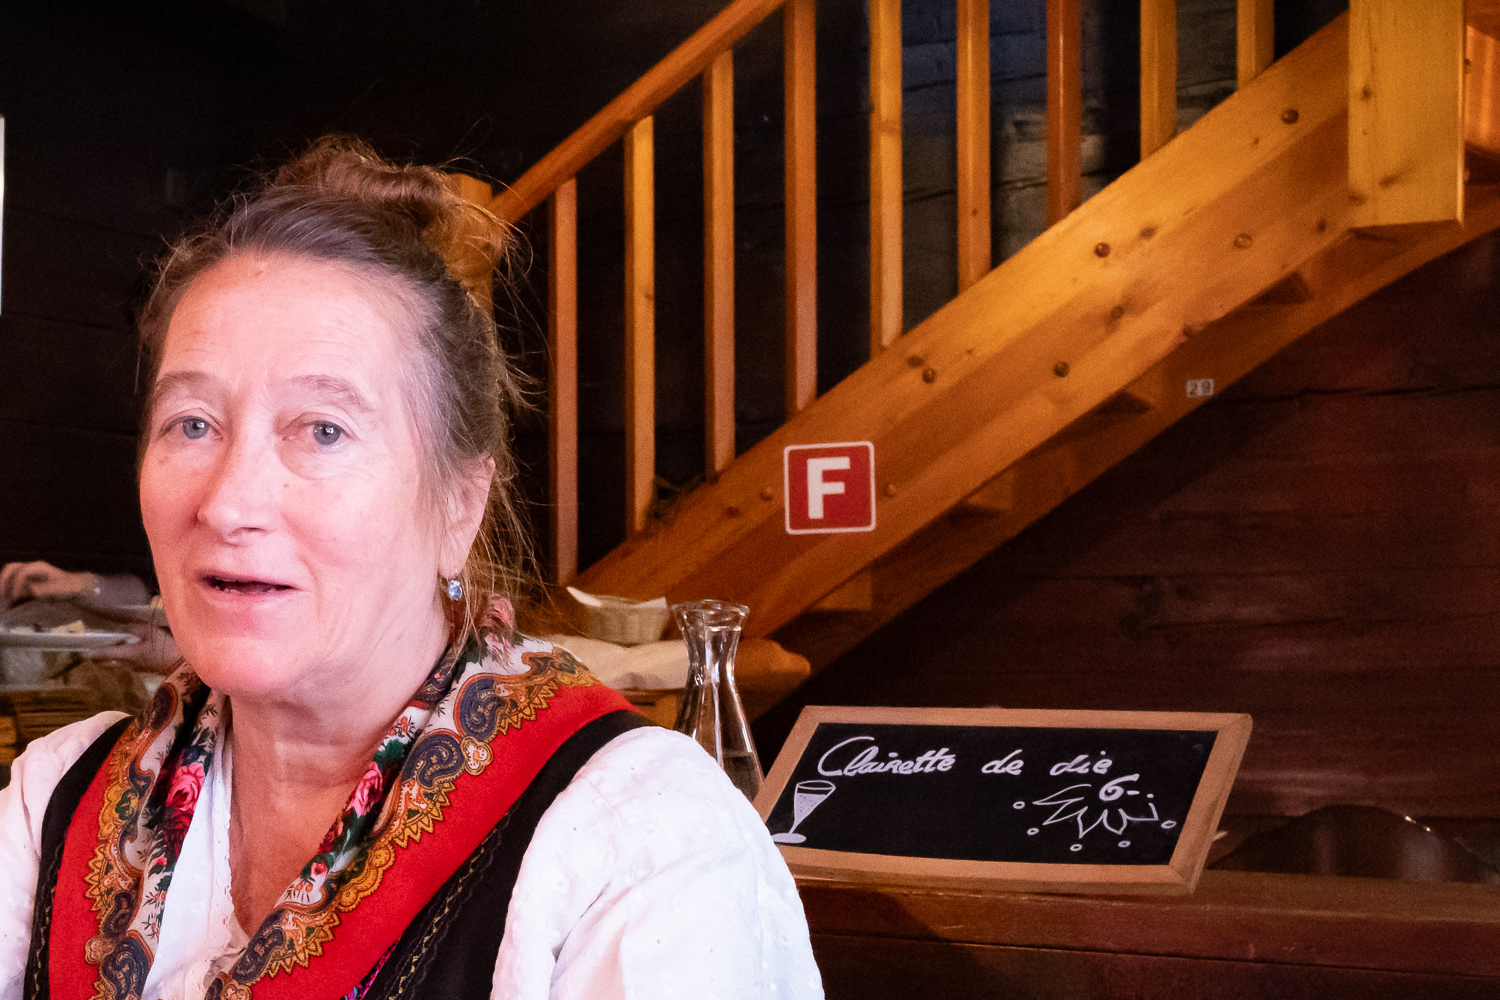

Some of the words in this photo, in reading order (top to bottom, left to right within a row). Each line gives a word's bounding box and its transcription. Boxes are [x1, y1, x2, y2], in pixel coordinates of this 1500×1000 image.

[807, 457, 851, 520] F
[817, 736, 956, 776] Clairette
[981, 750, 1025, 775] de
[1050, 750, 1113, 776] die
